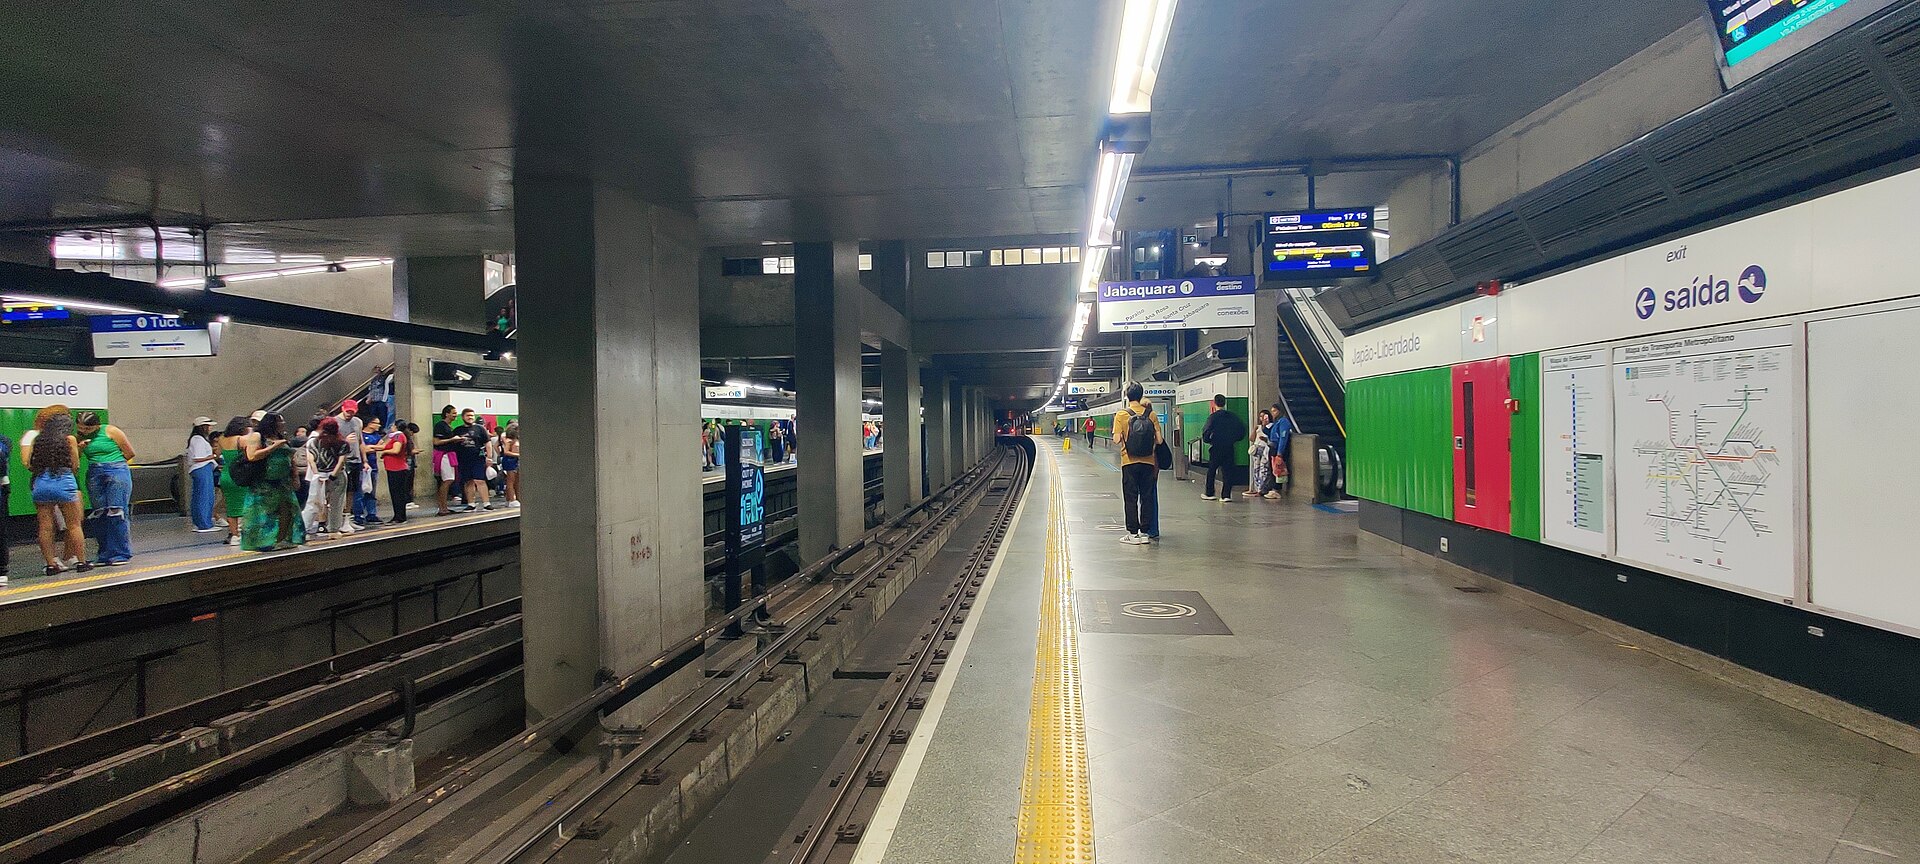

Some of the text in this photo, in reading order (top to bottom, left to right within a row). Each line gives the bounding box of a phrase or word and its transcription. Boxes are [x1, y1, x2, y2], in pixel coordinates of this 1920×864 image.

[1666, 245, 1687, 262] exit
[1103, 284, 1176, 298] Jabaquara
[1664, 275, 1730, 312] saída
[1145, 305, 1169, 321] Ana Rosa
[1163, 302, 1192, 320] Santa Cruz
[1183, 302, 1210, 321] Jabaquara
[1684, 334, 1735, 346] Metropolitano
[1352, 332, 1421, 367] Japão-Liberdade
